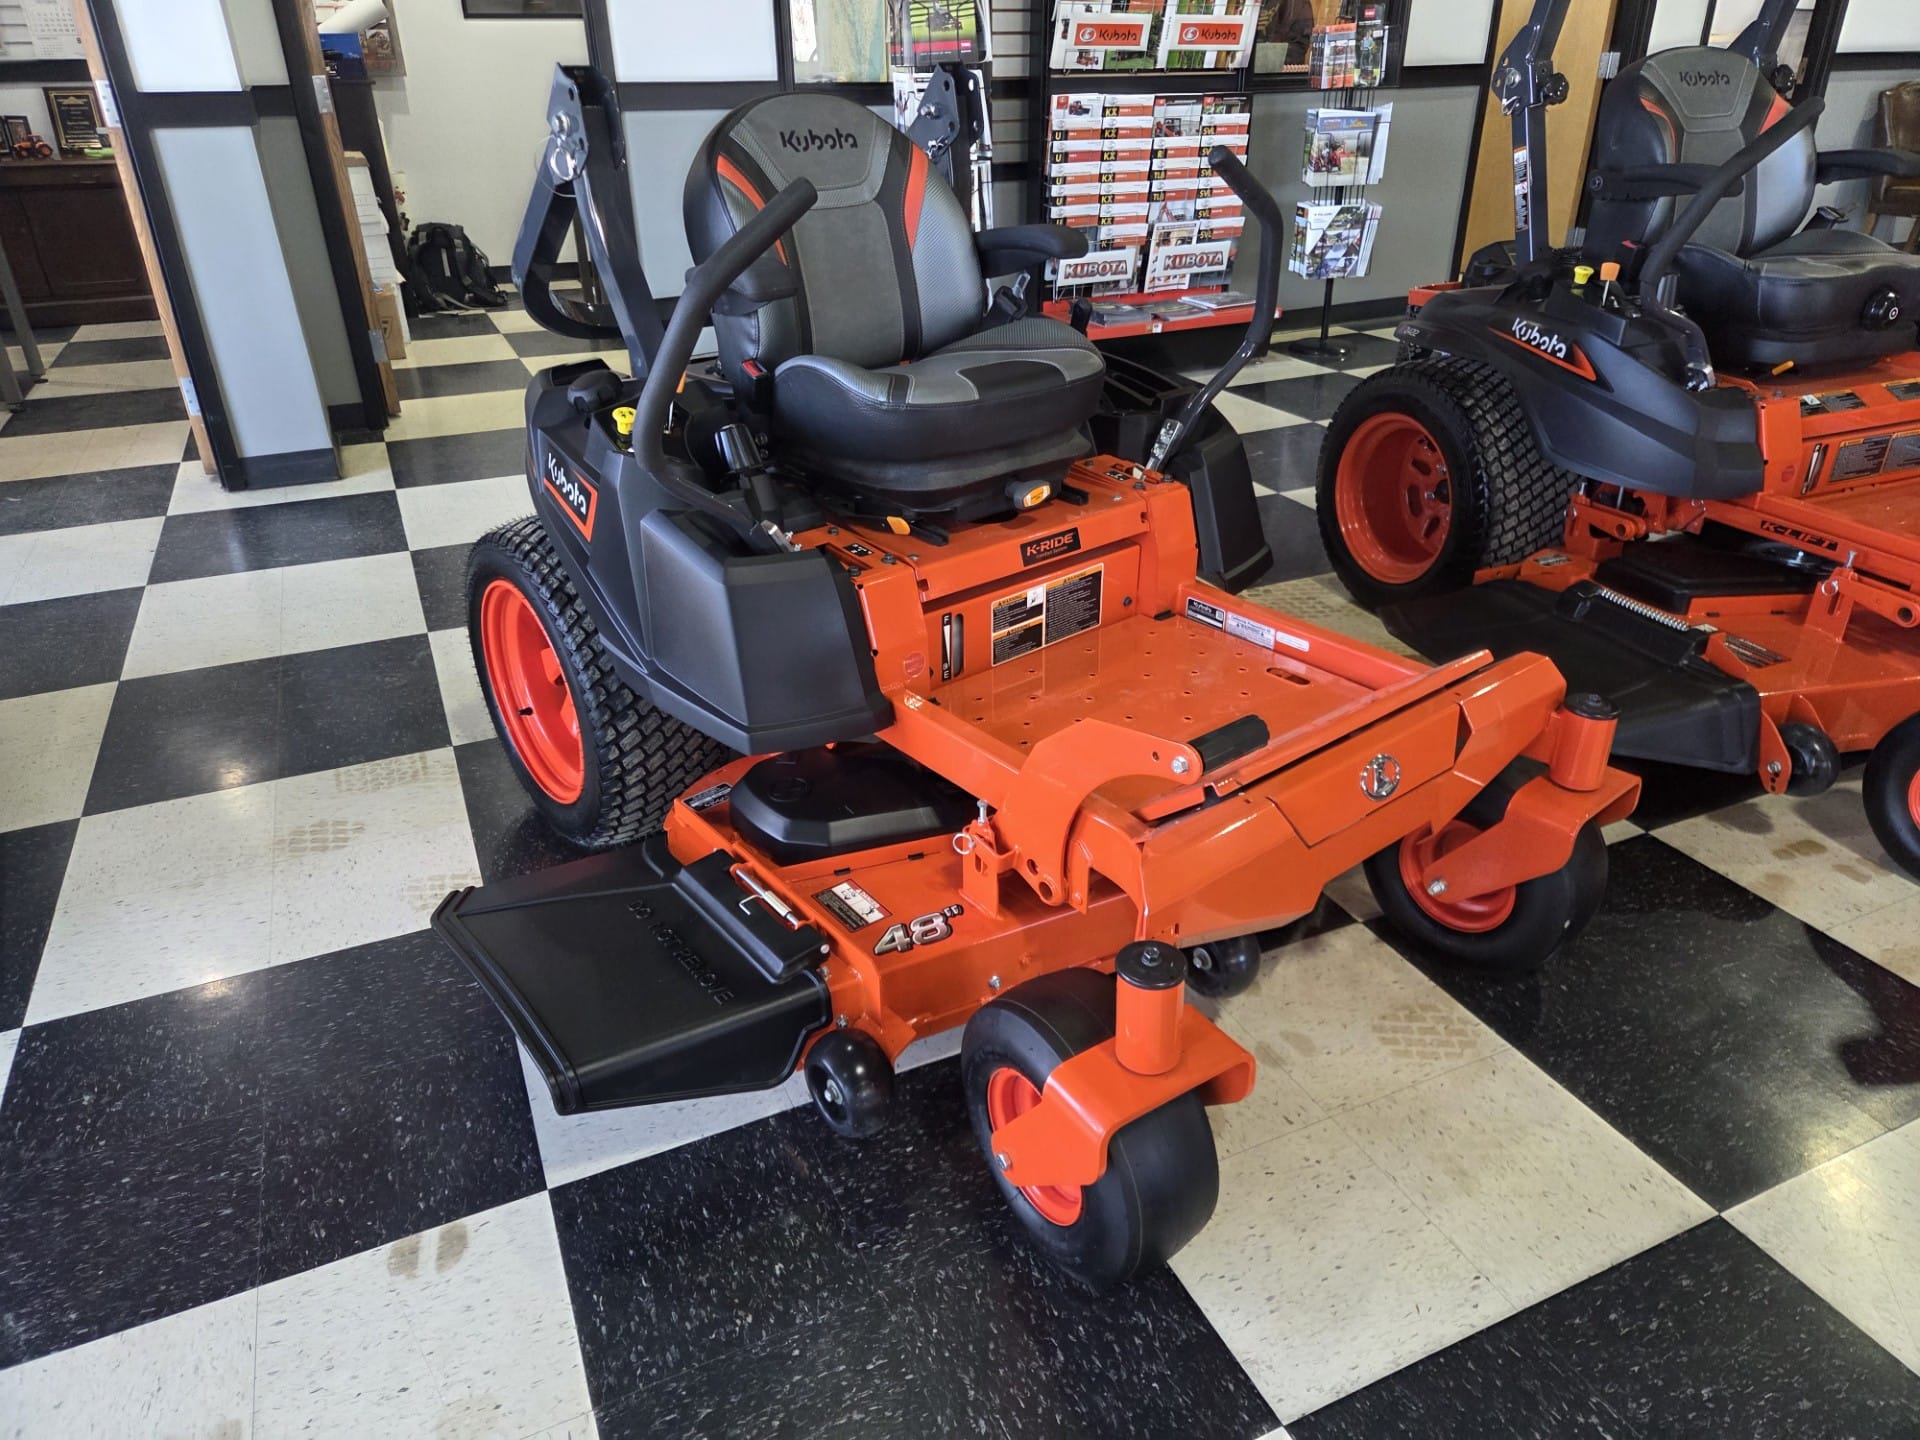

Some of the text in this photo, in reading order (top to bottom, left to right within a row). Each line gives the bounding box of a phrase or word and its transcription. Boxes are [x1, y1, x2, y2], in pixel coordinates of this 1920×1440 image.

[1099, 28, 1137, 41] Kubota
[1201, 28, 1237, 40] Kubota
[1679, 70, 1730, 87] Kubota
[1105, 107, 1117, 116] KX
[779, 127, 858, 153] Kubota
[1104, 129, 1116, 138] KX
[1103, 151, 1116, 160] KX
[1101, 173, 1113, 182] KX
[1101, 194, 1113, 203] KX
[1101, 217, 1112, 225] KX
[1064, 260, 1128, 279] KUBOTA
[1163, 251, 1225, 271] KUBOTA
[1511, 317, 1567, 359] Kubota
[547, 452, 587, 515] Kubota
[1762, 520, 1838, 550] K-LIFT
[1026, 532, 1074, 557] K-RIDE
[873, 904, 964, 955] 48"
